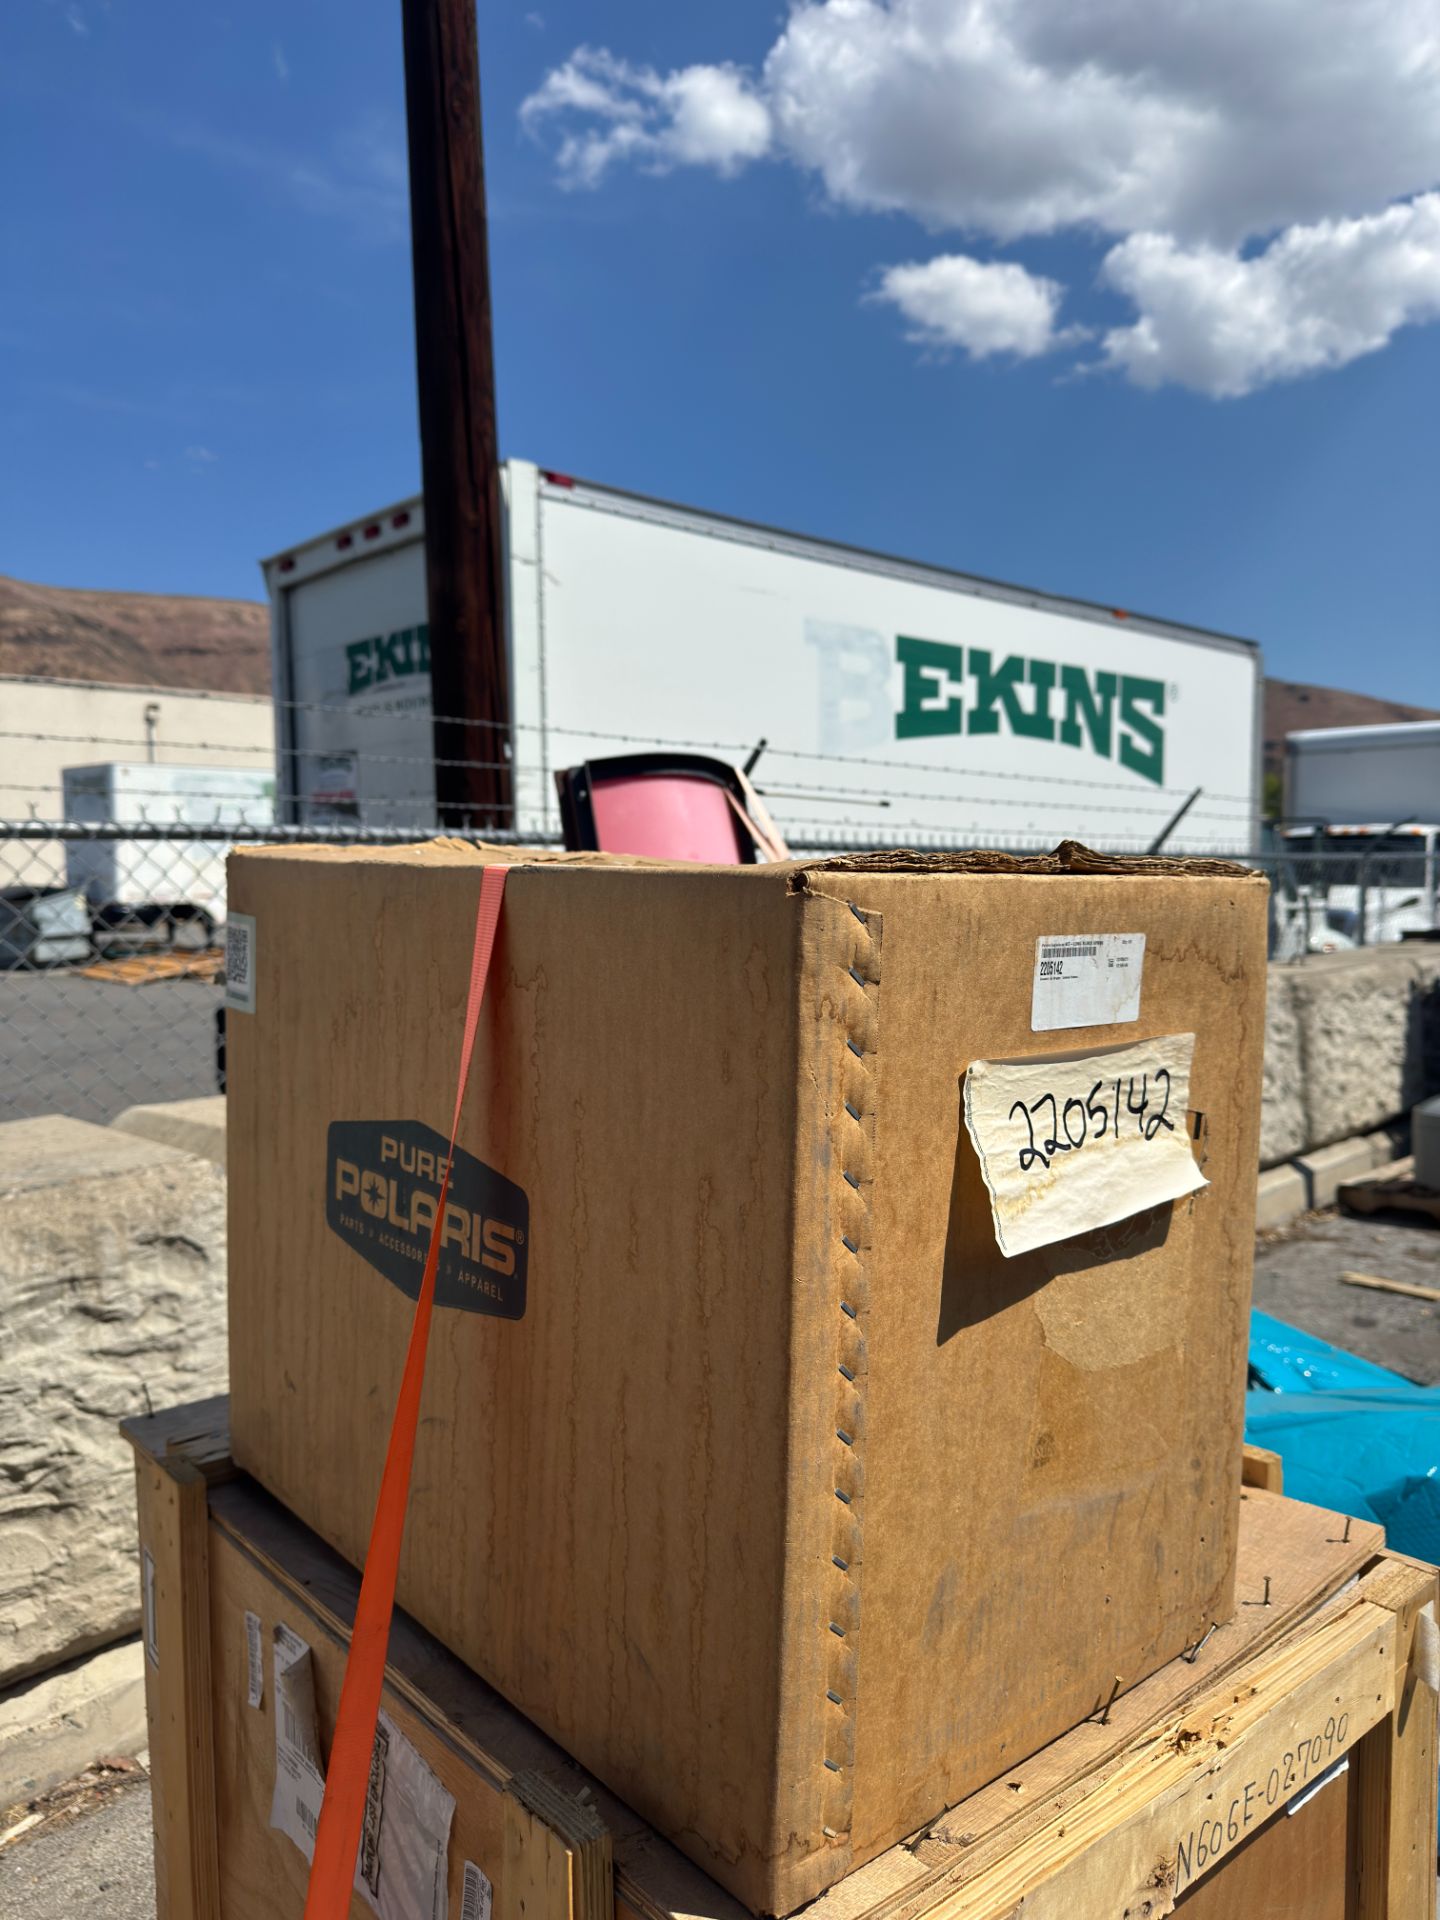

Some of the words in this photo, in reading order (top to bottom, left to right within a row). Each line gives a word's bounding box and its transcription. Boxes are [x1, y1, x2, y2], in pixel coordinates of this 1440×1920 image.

[1040, 960, 1064, 976] 2205142
[381, 1136, 455, 1188] PURE
[1009, 1068, 1174, 1171] 2205142
[340, 1213, 365, 1235] PARTS
[378, 1233, 439, 1271] ACCESSORI
[458, 1270, 504, 1301] APPAREL
[1174, 1713, 1349, 1894] N606E-027090
